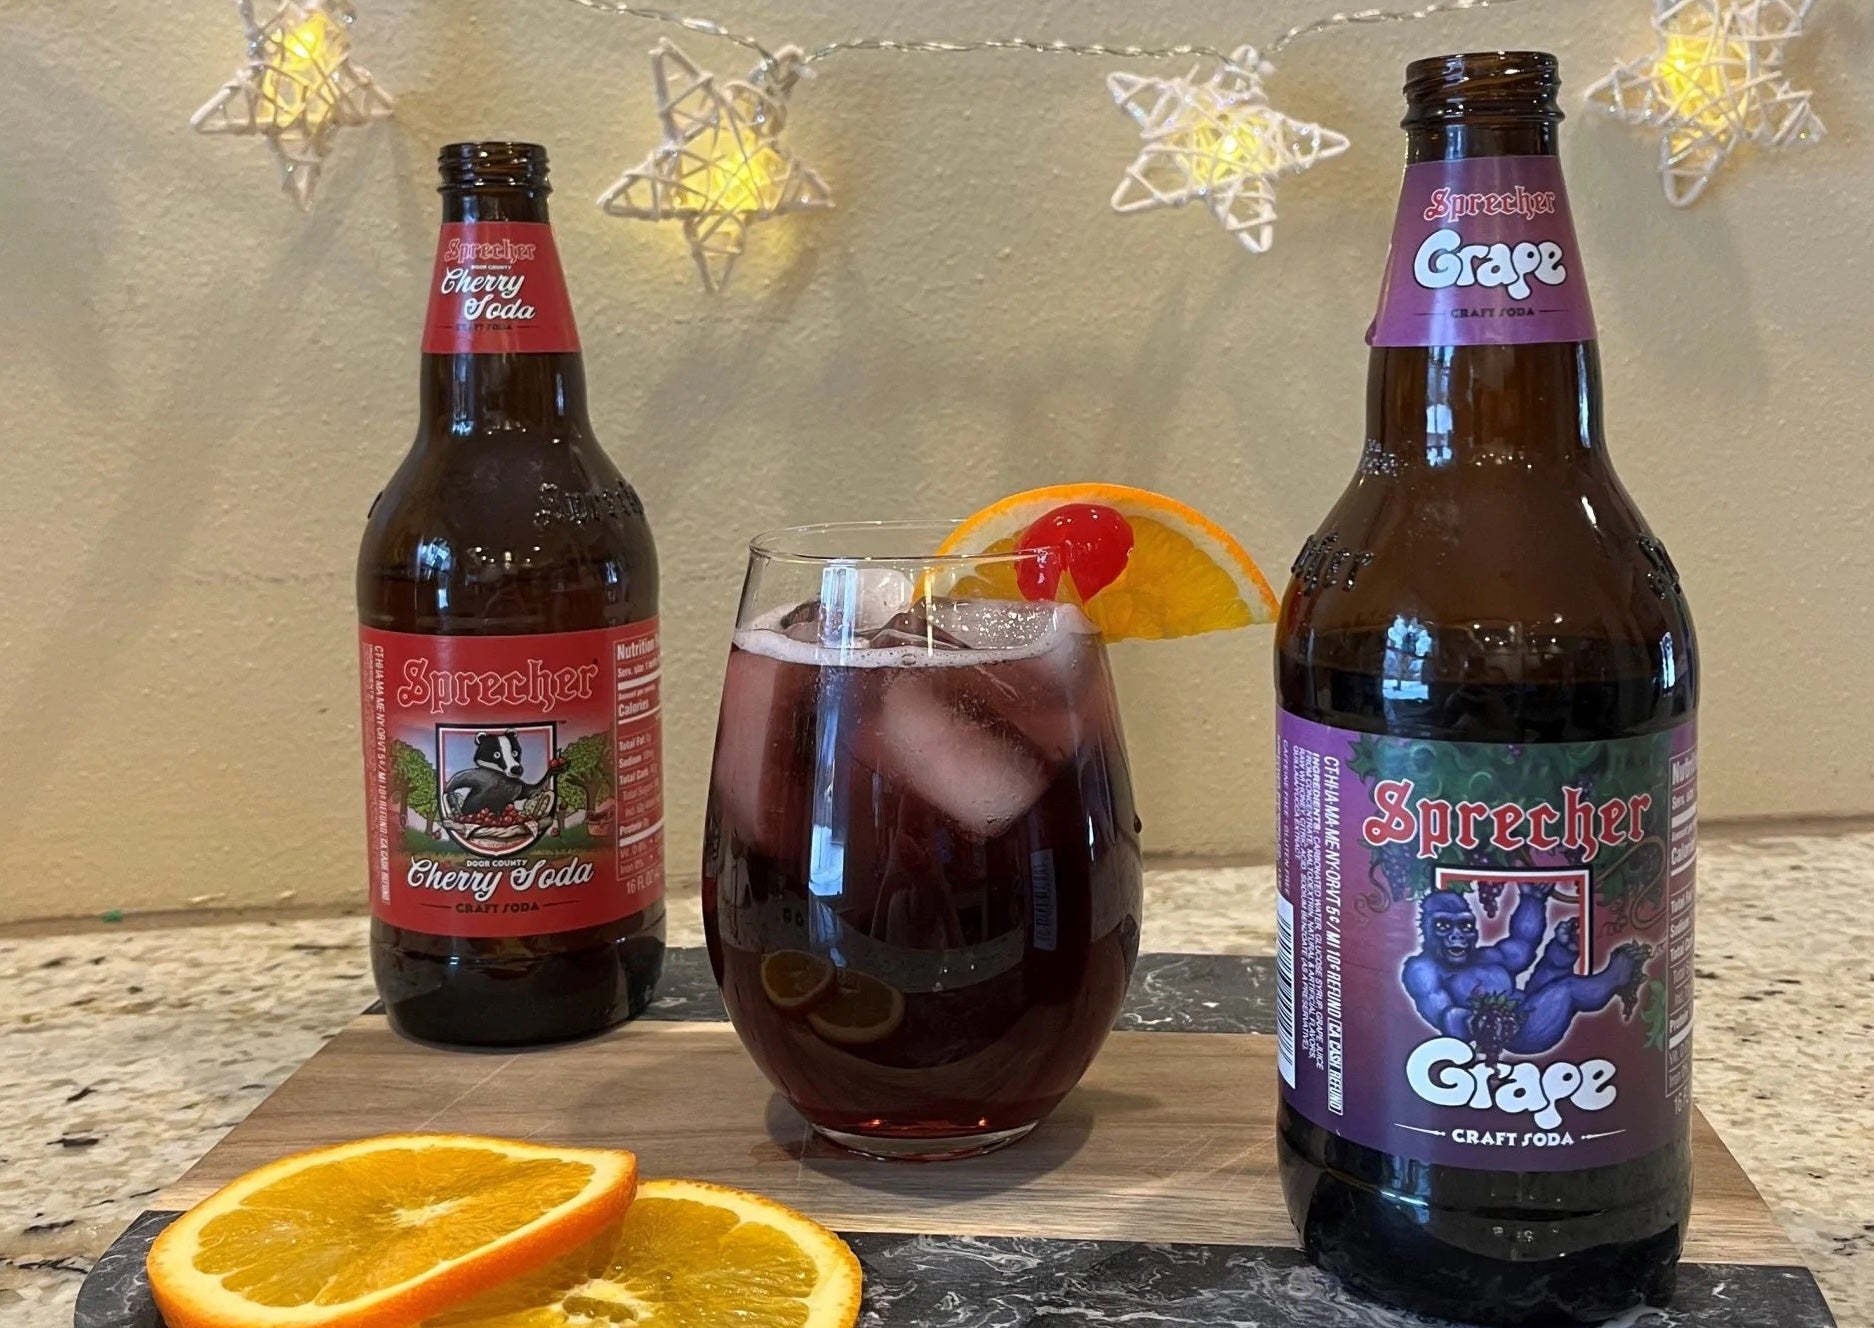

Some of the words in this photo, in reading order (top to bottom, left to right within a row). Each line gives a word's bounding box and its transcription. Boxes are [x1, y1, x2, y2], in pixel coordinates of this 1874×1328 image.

[1424, 185, 1556, 222] Sprecher
[444, 238, 536, 264] Sprecher
[1414, 228, 1567, 300] Grape
[441, 267, 525, 299] Cherry
[464, 293, 535, 320] Soda
[1451, 308, 1494, 318] CRAFT
[1499, 307, 1534, 317] SODA
[617, 638, 655, 660] Nutrition
[398, 657, 598, 714] Sprecher
[618, 700, 648, 717] Calories
[1312, 753, 1321, 833] INGREDIENTS:
[1362, 778, 1652, 862] Sprecher
[407, 856, 504, 901] Cherry
[510, 857, 594, 891] Soda
[1313, 836, 1321, 897] CARBONATED
[456, 902, 498, 914] CRAFT
[503, 901, 540, 913] SODA
[1307, 920, 1315, 960] NATURAL
[1314, 933, 1322, 978] GLUCOSE
[1308, 970, 1316, 1015] ARTIFICIAL
[1327, 970, 1341, 1019] REFUND
[1329, 1023, 1341, 1038] CA
[1329, 1040, 1341, 1069] CASH
[1329, 1070, 1341, 1110] REFUND
[1405, 1037, 1618, 1130] Grape
[1452, 1129, 1518, 1147] CRAFT
[1521, 1131, 1574, 1148] SODA
